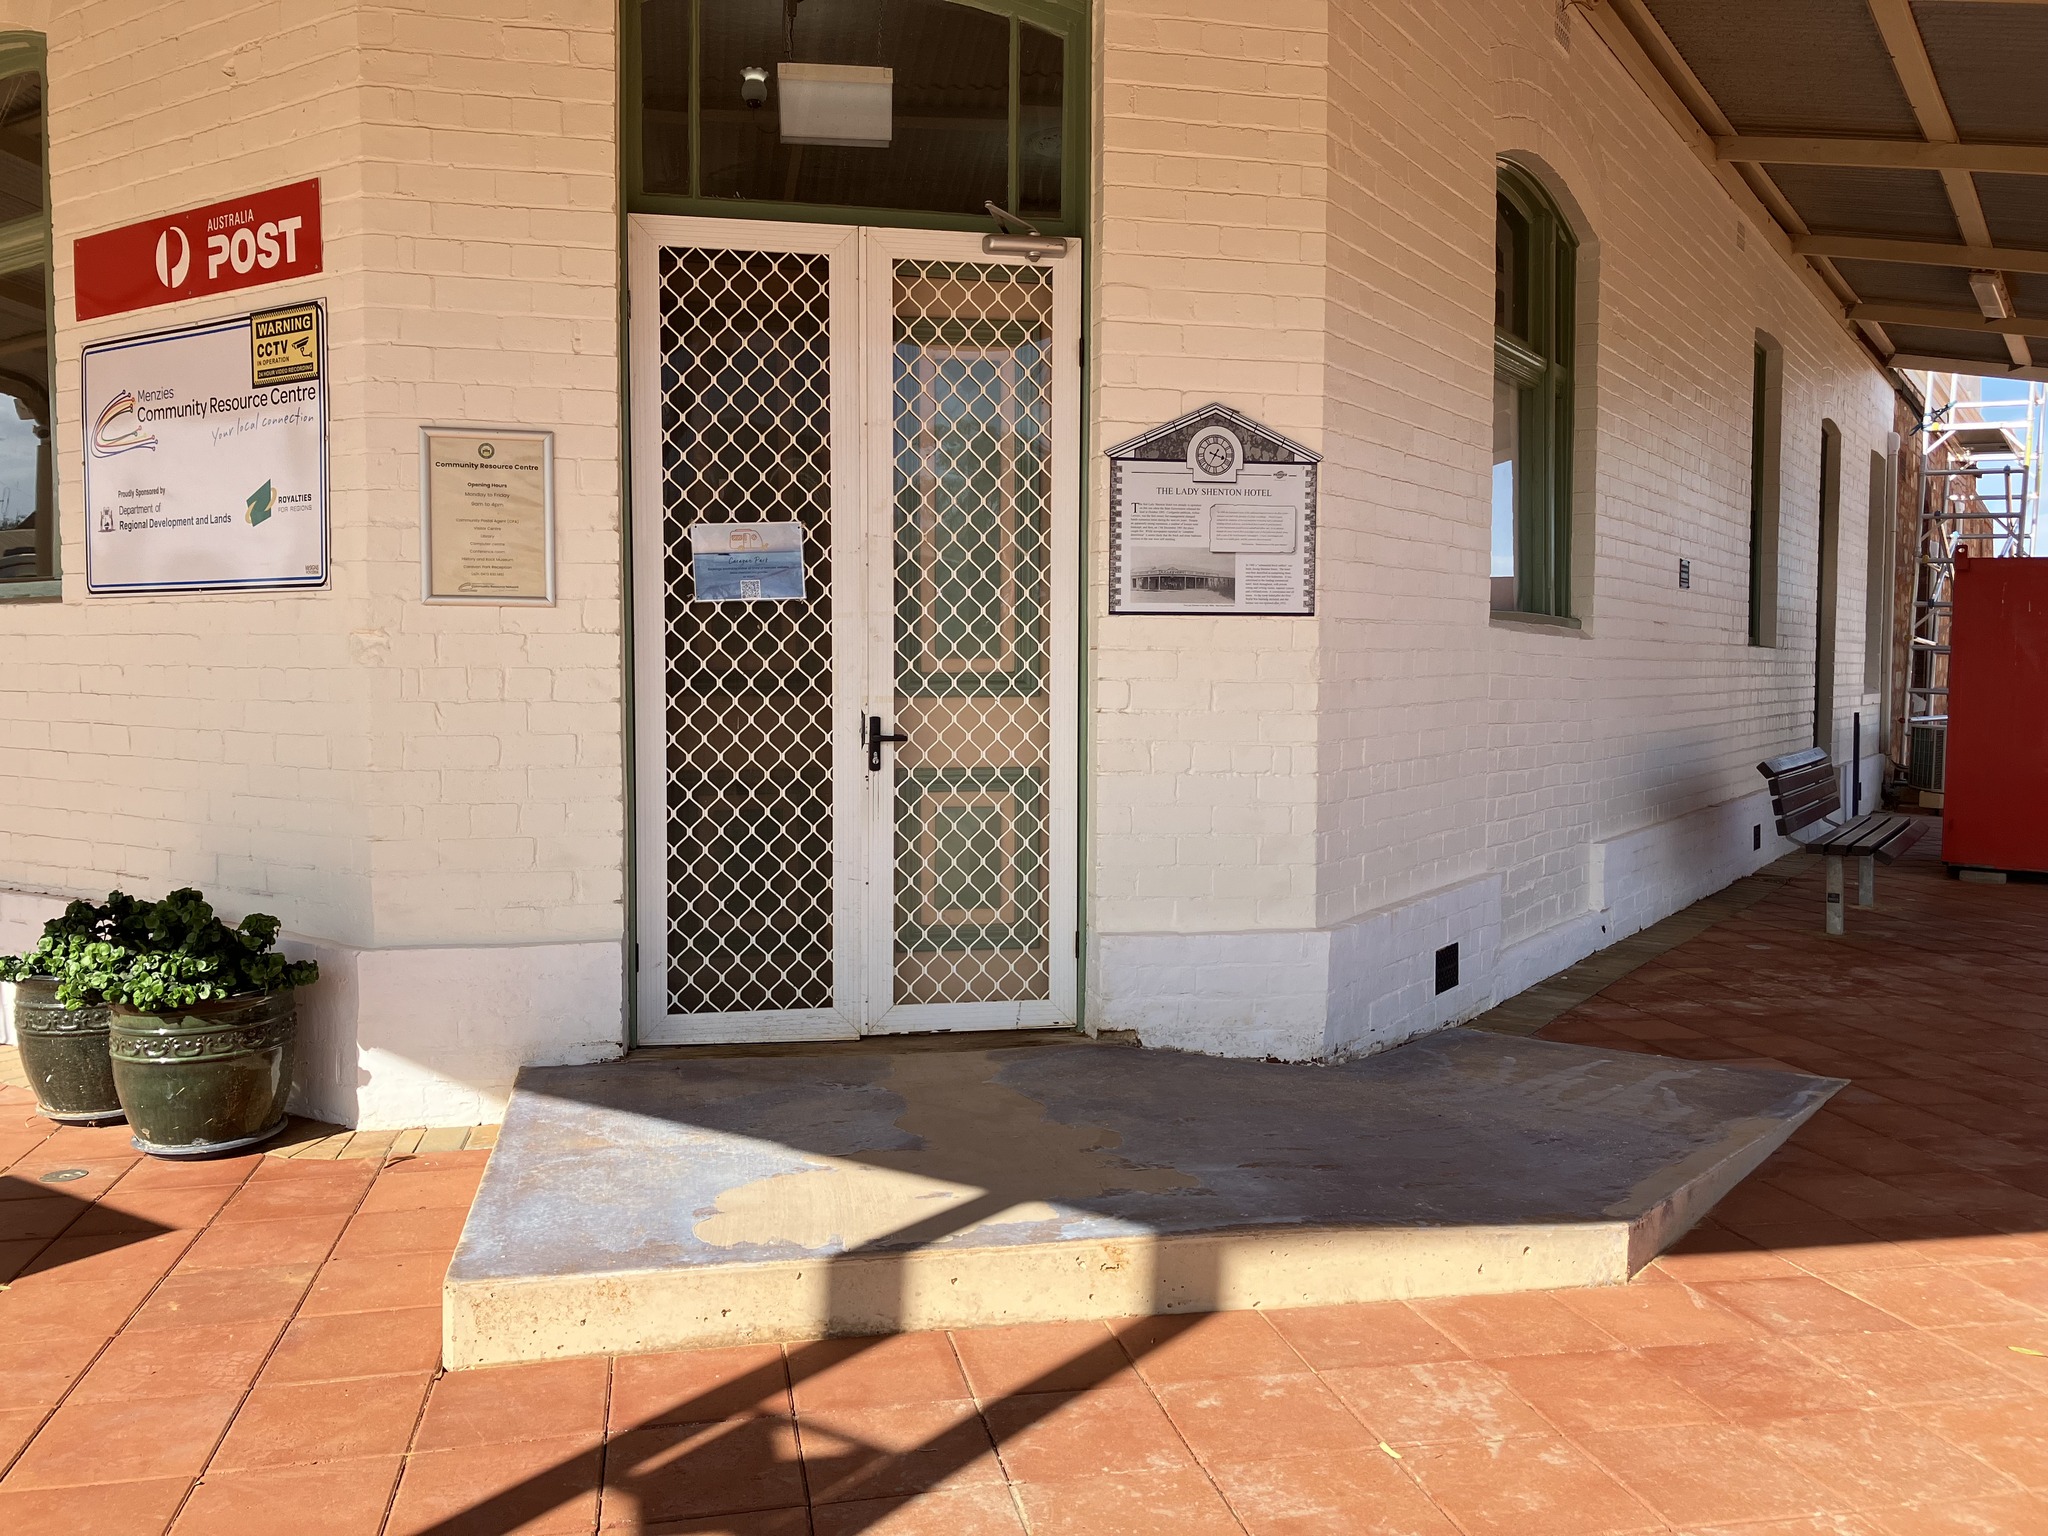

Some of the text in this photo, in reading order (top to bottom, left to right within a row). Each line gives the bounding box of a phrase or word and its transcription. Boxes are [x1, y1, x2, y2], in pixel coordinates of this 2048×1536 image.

[207, 208, 255, 232] AUSTRALIA
[207, 215, 302, 279] POST
[257, 315, 311, 337] WARNING
[257, 339, 288, 358] CCTV
[263, 356, 290, 366] OPERATION
[263, 369, 275, 377] HOUR
[275, 367, 288, 375] VIDEO
[288, 364, 313, 373] RECORDING
[137, 386, 175, 402] Menzies
[137, 385, 316, 423] Community Resource Centre
[211, 406, 314, 447] Your local connection
[435, 461, 479, 470] Community
[118, 486, 166, 499] Proudly Sponsored by
[278, 493, 312, 504] ROYALTIES
[1156, 486, 1272, 497] THE LADY SHENTON HOTEL
[119, 502, 161, 517] Department of
[290, 504, 312, 512] REGIONS
[119, 513, 232, 532] Regional Development and Lands
